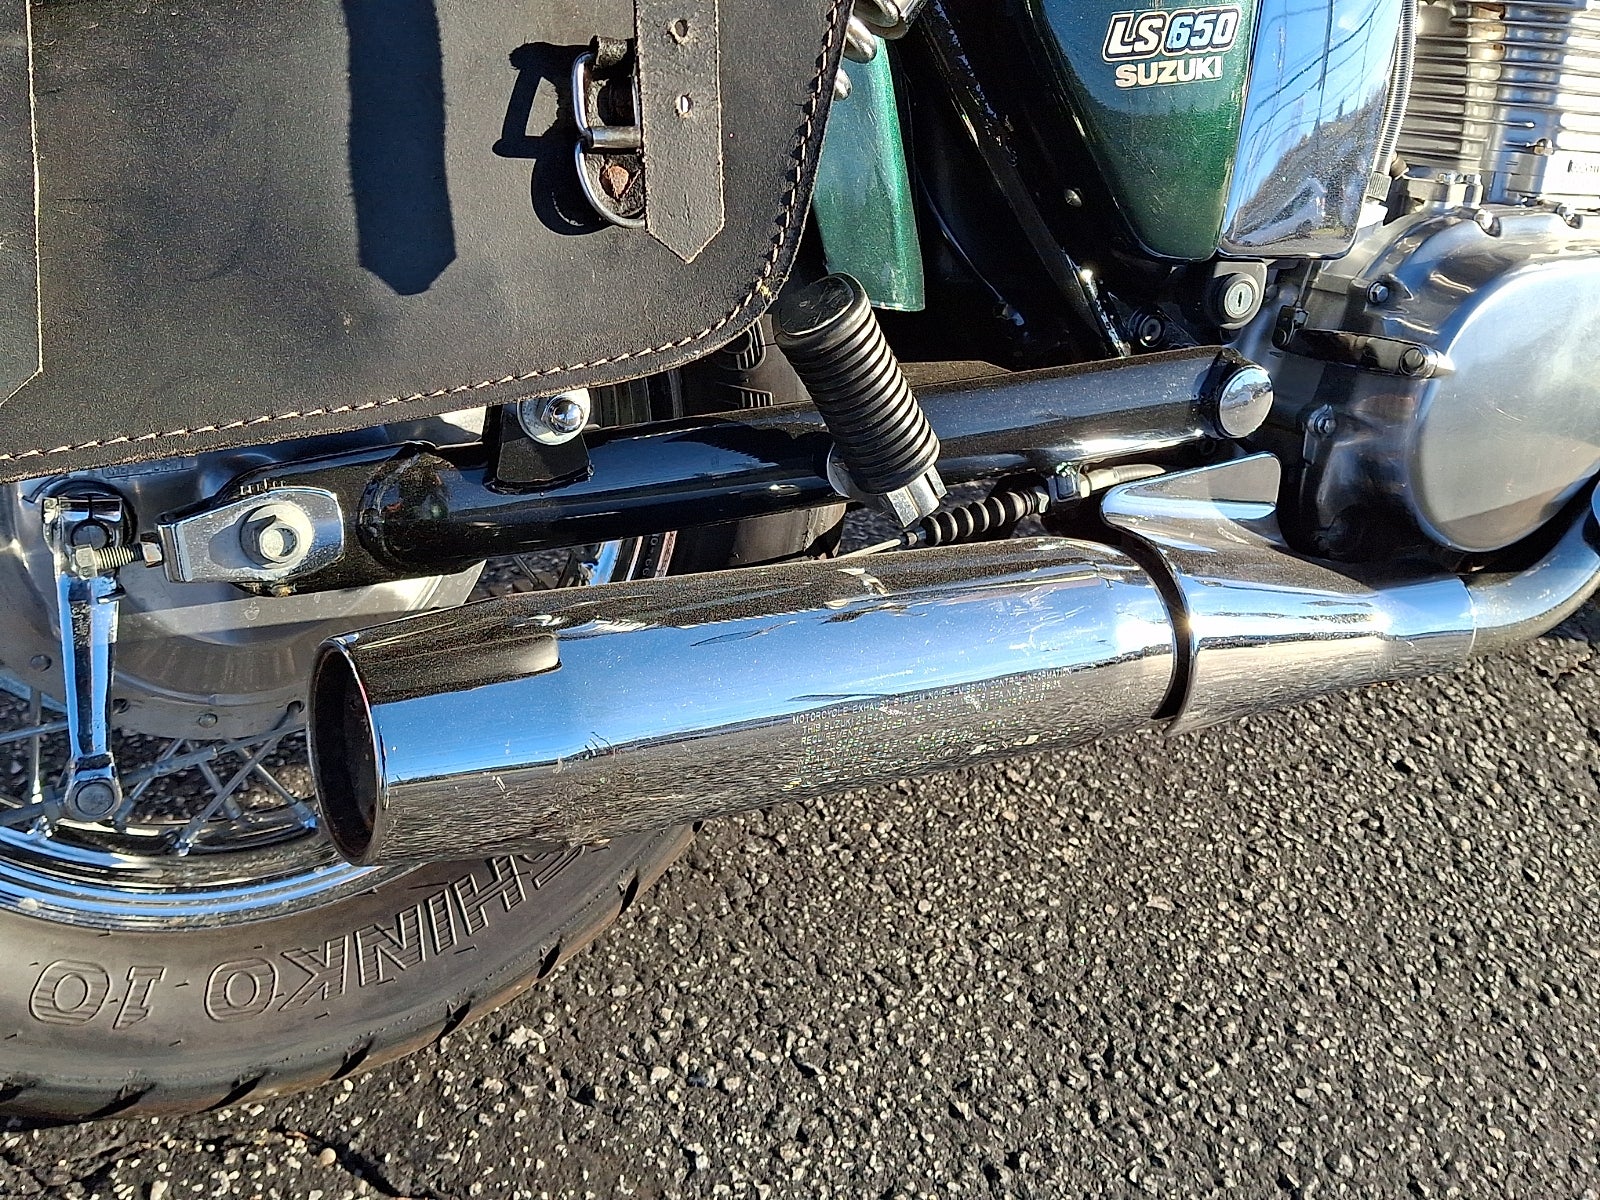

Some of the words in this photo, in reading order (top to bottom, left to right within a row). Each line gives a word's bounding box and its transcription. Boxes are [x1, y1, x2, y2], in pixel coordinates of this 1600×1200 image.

[1104, 8, 1240, 59] LS650
[1115, 56, 1222, 88] SUZUKI
[792, 707, 848, 723] MOTORCYCLE
